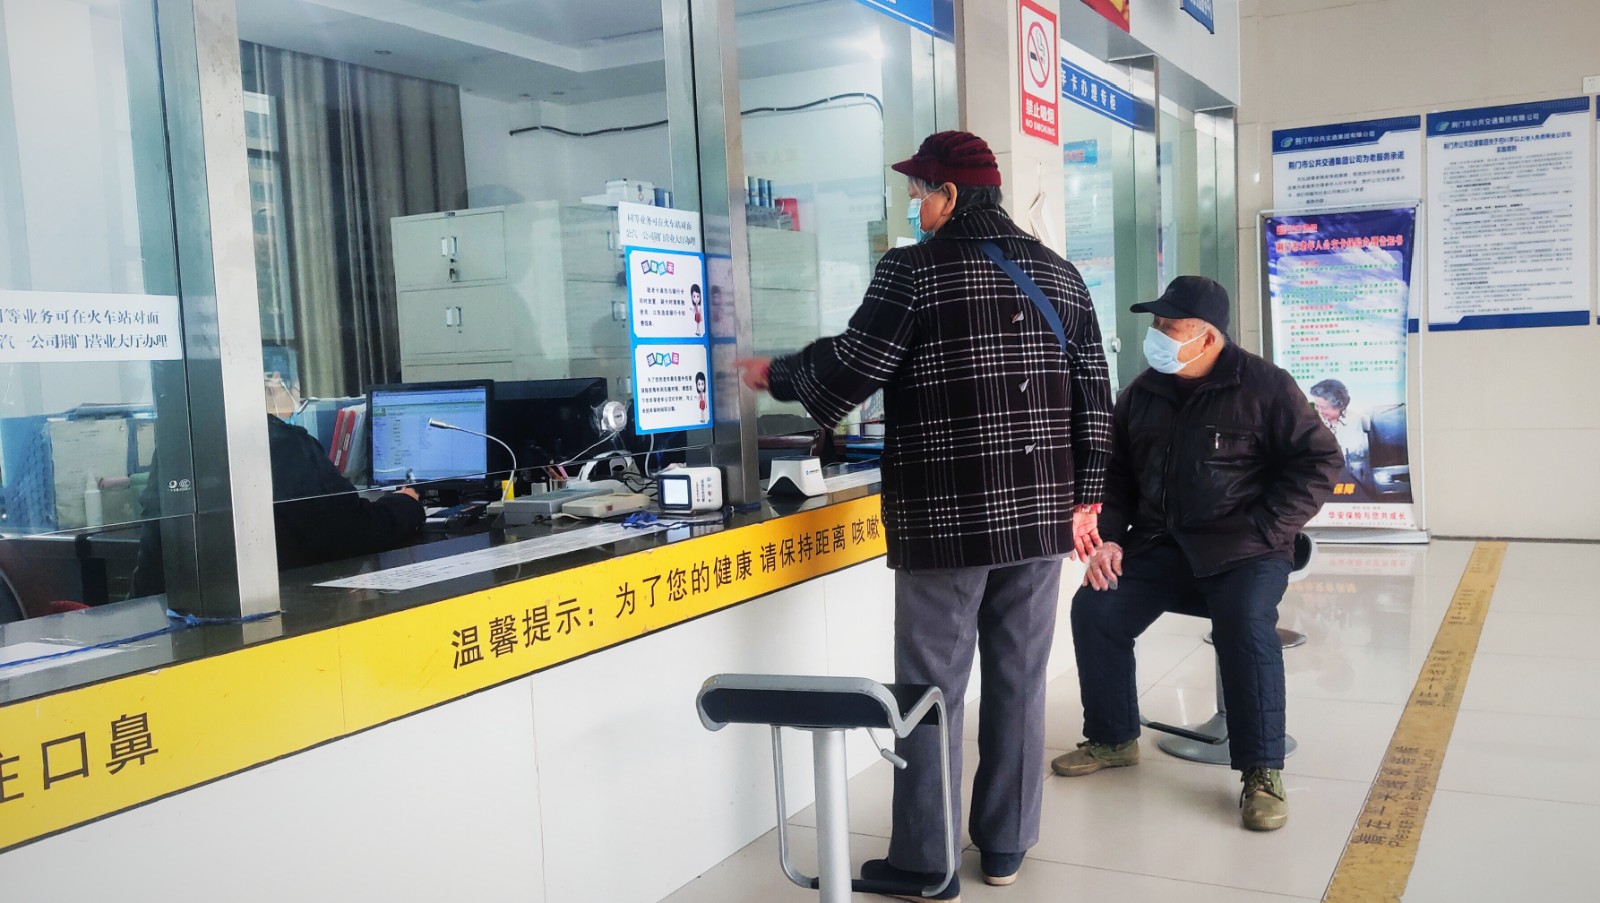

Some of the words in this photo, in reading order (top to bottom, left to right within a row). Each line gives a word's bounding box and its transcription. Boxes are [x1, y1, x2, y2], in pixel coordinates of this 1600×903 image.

[1025, 98, 1055, 125] 禁止吸烟
[1450, 112, 1540, 129] 荆门市公共交通集团有限公司
[1025, 119, 1034, 128] NO
[1034, 122, 1056, 137] SMOKING
[1294, 130, 1376, 146] 荆门市公共交通集团有限公司
[1288, 151, 1405, 170] 荆门市公共交通集团公司为老服务承诺
[1328, 511, 1406, 520] 华安保险与您共成长
[760, 524, 847, 573] 请保持距离
[851, 518, 880, 544] 咳嗽
